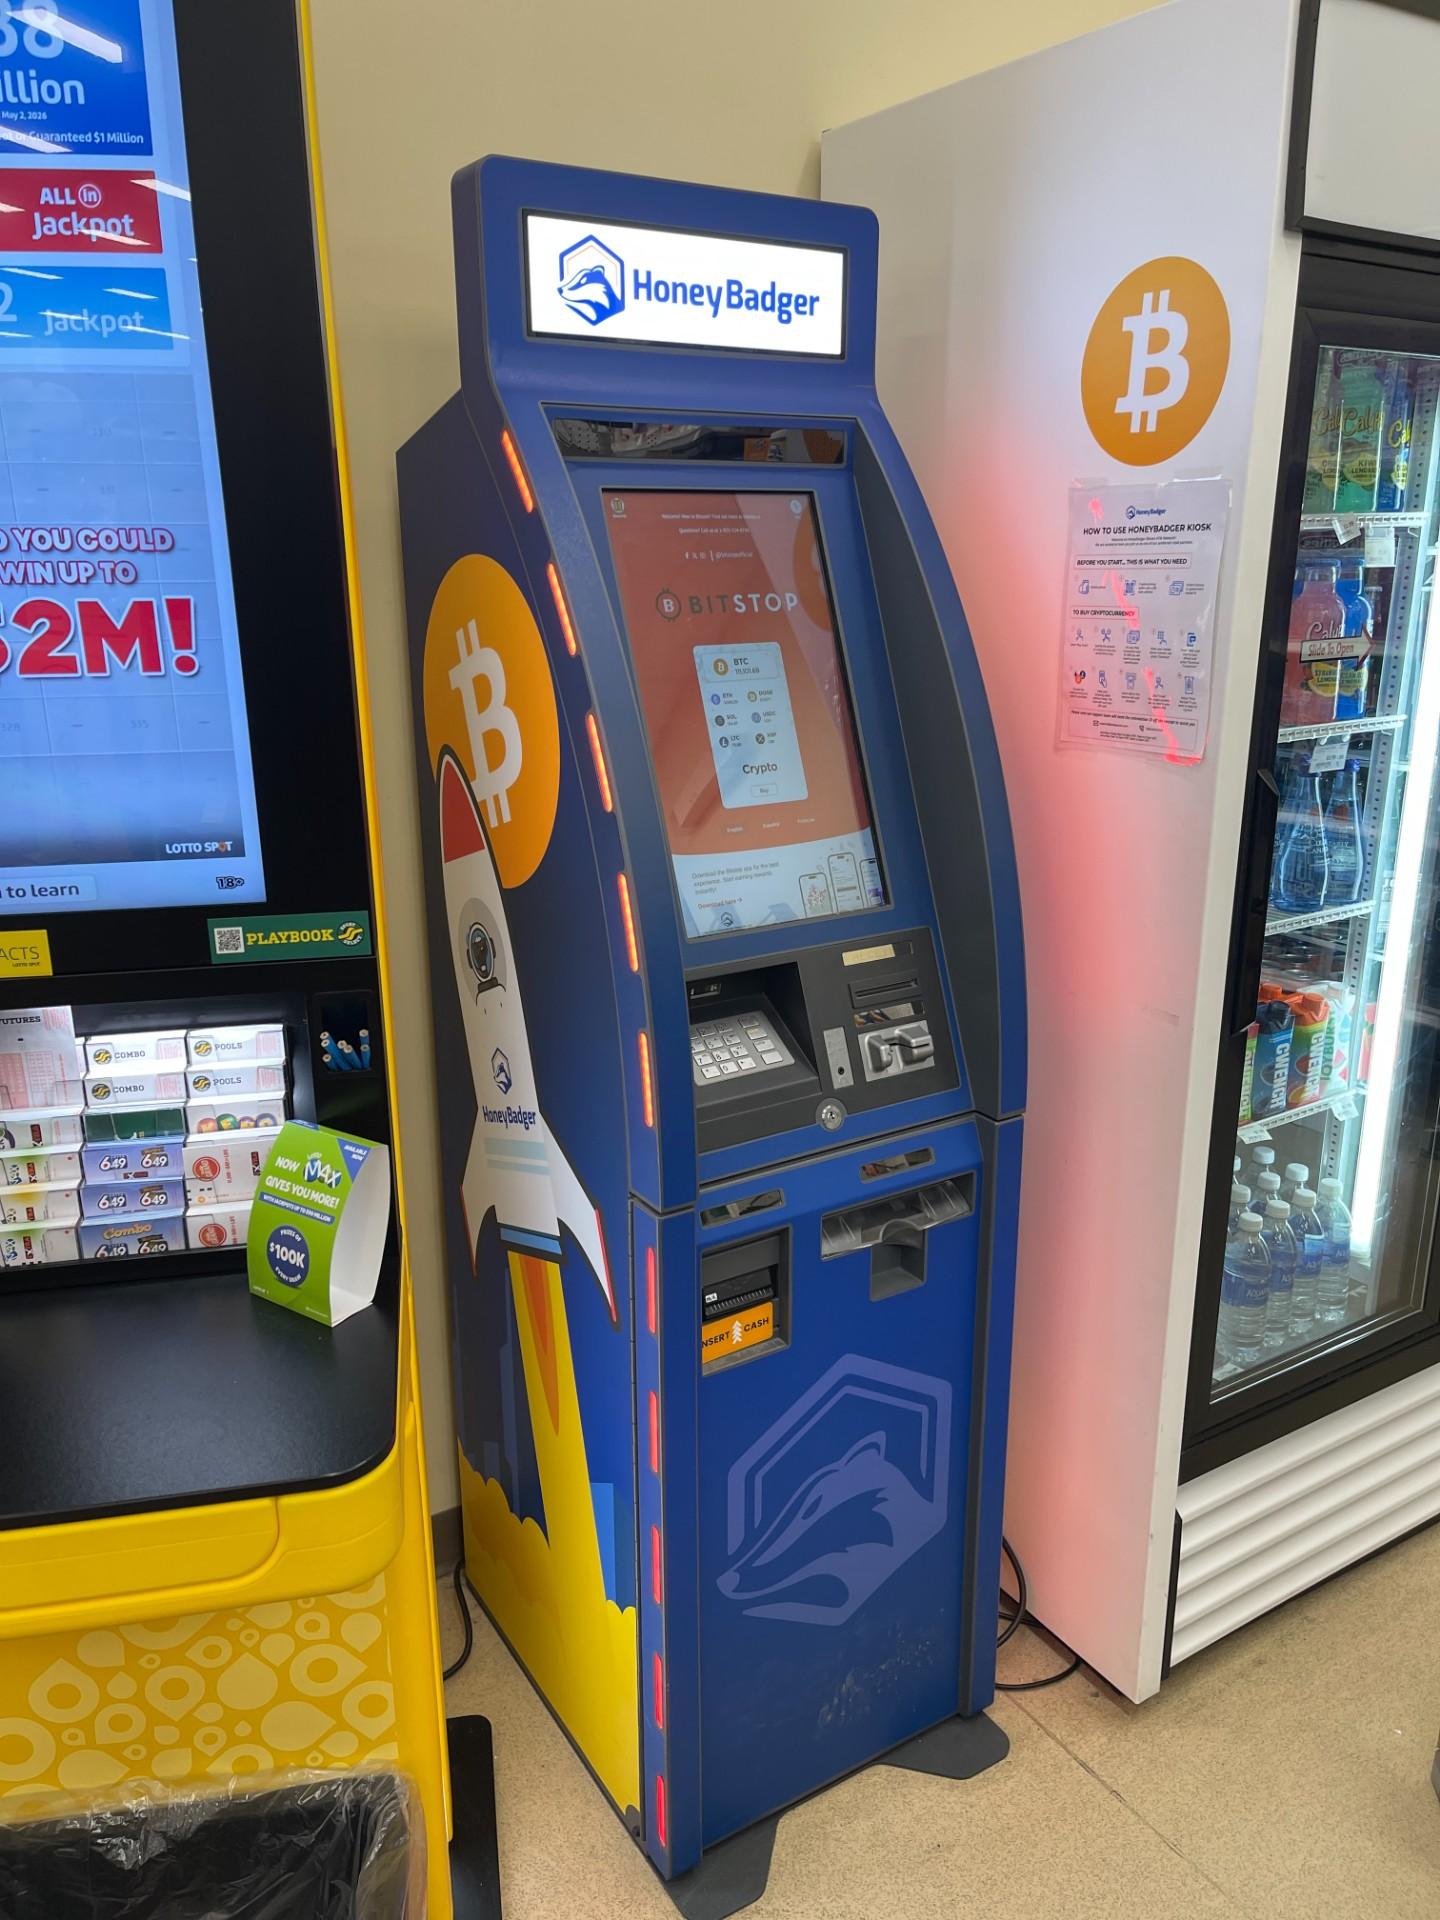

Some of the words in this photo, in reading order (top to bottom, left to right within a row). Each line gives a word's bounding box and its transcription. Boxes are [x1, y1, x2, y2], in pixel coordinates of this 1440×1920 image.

[0, 69, 85, 104] llion
[2, 111, 18, 121] May
[20, 112, 27, 121] 2,
[28, 111, 47, 120] 2026
[28, 131, 92, 143] Guaranteed
[94, 133, 105, 143] $1
[107, 133, 144, 144] Million
[40, 188, 76, 205] ALL
[33, 213, 134, 241] Jackpot
[633, 269, 820, 325] HoneyBadger
[44, 309, 144, 337] Jackpot
[1113, 526, 1126, 534] USE
[1128, 524, 1185, 533] HONEYBADGER
[1187, 523, 1212, 531] KIOSK
[11, 528, 73, 551] YOU
[76, 528, 174, 551] COULD
[0, 561, 54, 584] WIN
[57, 561, 95, 584] UP
[99, 561, 137, 583] TO
[689, 593, 798, 614] BITSTOP
[0, 597, 199, 678] 2M!
[1308, 644, 1326, 656] Slide
[1327, 643, 1335, 655] To
[1336, 642, 1354, 656] Open
[742, 763, 778, 775] Crypto
[165, 843, 201, 854] LOTTO
[204, 841, 232, 853] SPOT
[6, 886, 26, 898] to
[31, 884, 79, 897] learn
[216, 876, 244, 890] 18+
[246, 929, 334, 945] PLAYBOOK
[114, 1050, 146, 1059] COMBO
[215, 1042, 243, 1051] POOLS
[213, 1077, 242, 1086] POOLS
[1270, 1042, 1291, 1110] CWENCH
[113, 1083, 145, 1093] COMBO
[482, 1105, 536, 1130] HoneyBadger
[275, 1156, 300, 1172] NOW
[305, 1159, 341, 1188] MAX
[265, 1175, 291, 1193] GIVES
[291, 1183, 310, 1199] YOU
[310, 1190, 340, 1209] MORE!
[104, 1223, 151, 1239] Combo
[269, 1242, 305, 1268] $100K
[702, 1332, 730, 1348] NSERT
[744, 1317, 769, 1332] CASH
